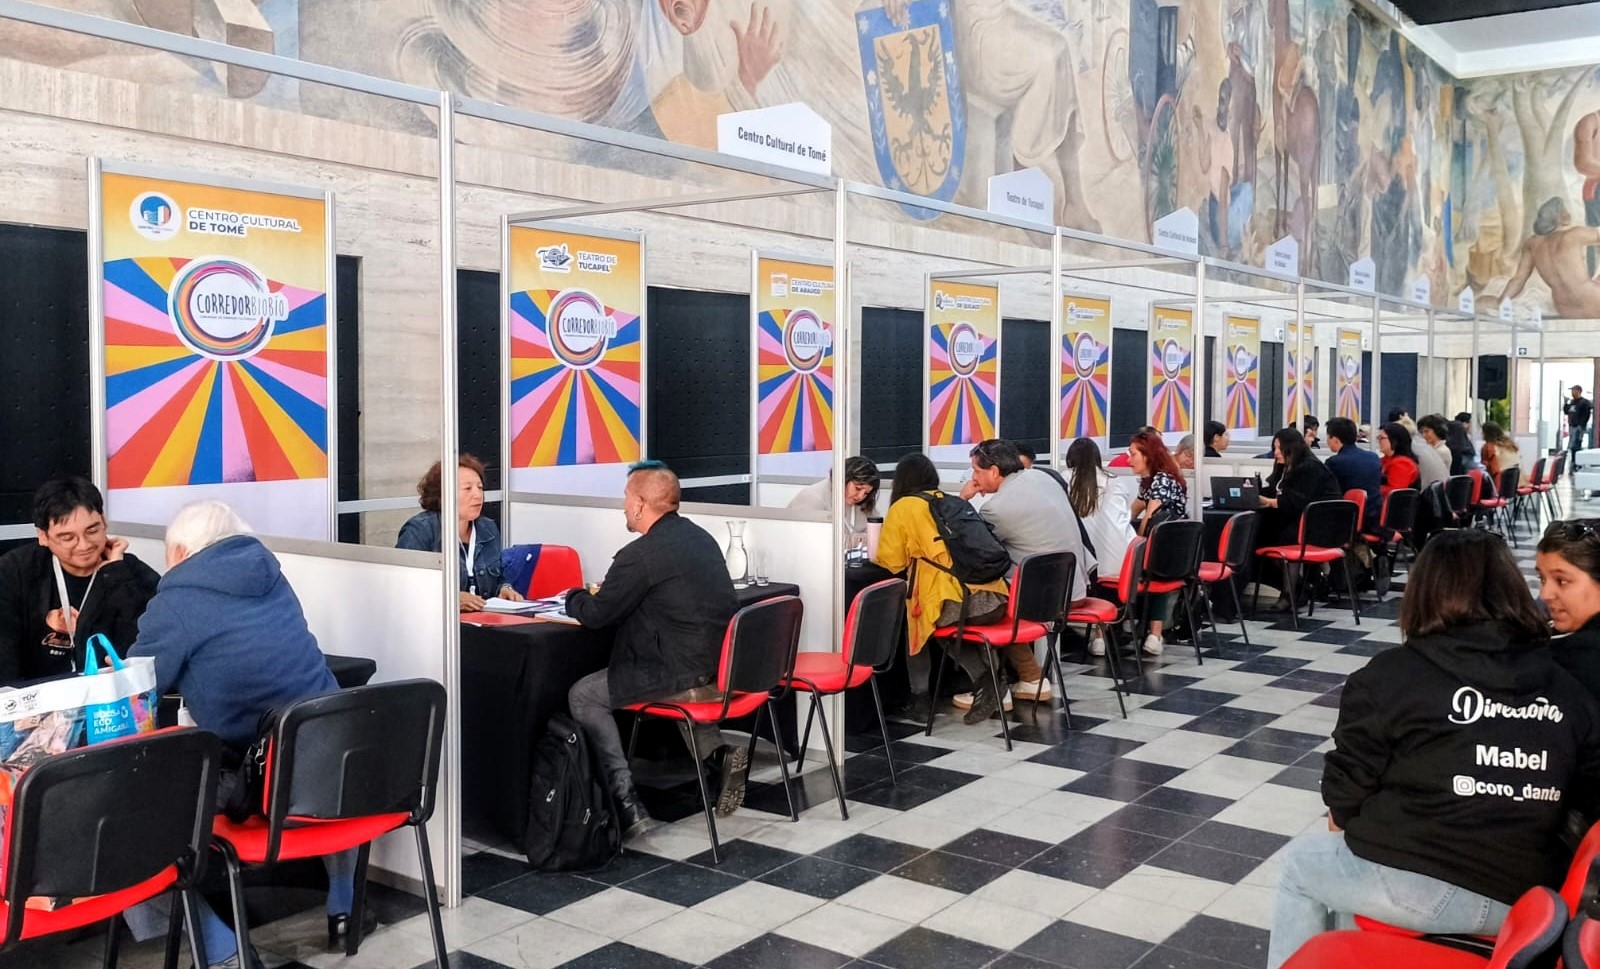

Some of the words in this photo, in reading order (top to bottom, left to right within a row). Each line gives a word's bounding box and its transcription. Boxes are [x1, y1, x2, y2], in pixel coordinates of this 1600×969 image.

[738, 126, 764, 145] Centro
[766, 134, 796, 154] Cultural
[797, 144, 806, 156] de
[808, 146, 826, 162] Tomé
[188, 209, 238, 224] CENTRO
[241, 215, 300, 231] CULTURAL
[189, 221, 206, 232] DE
[211, 221, 245, 235] TOMÉ
[579, 253, 605, 262] TEATRO
[579, 262, 610, 271] TUCAPEL
[812, 281, 835, 289] CULTURA
[1475, 744, 1548, 771] Mabel
[1475, 780, 1562, 802] coro_dante
